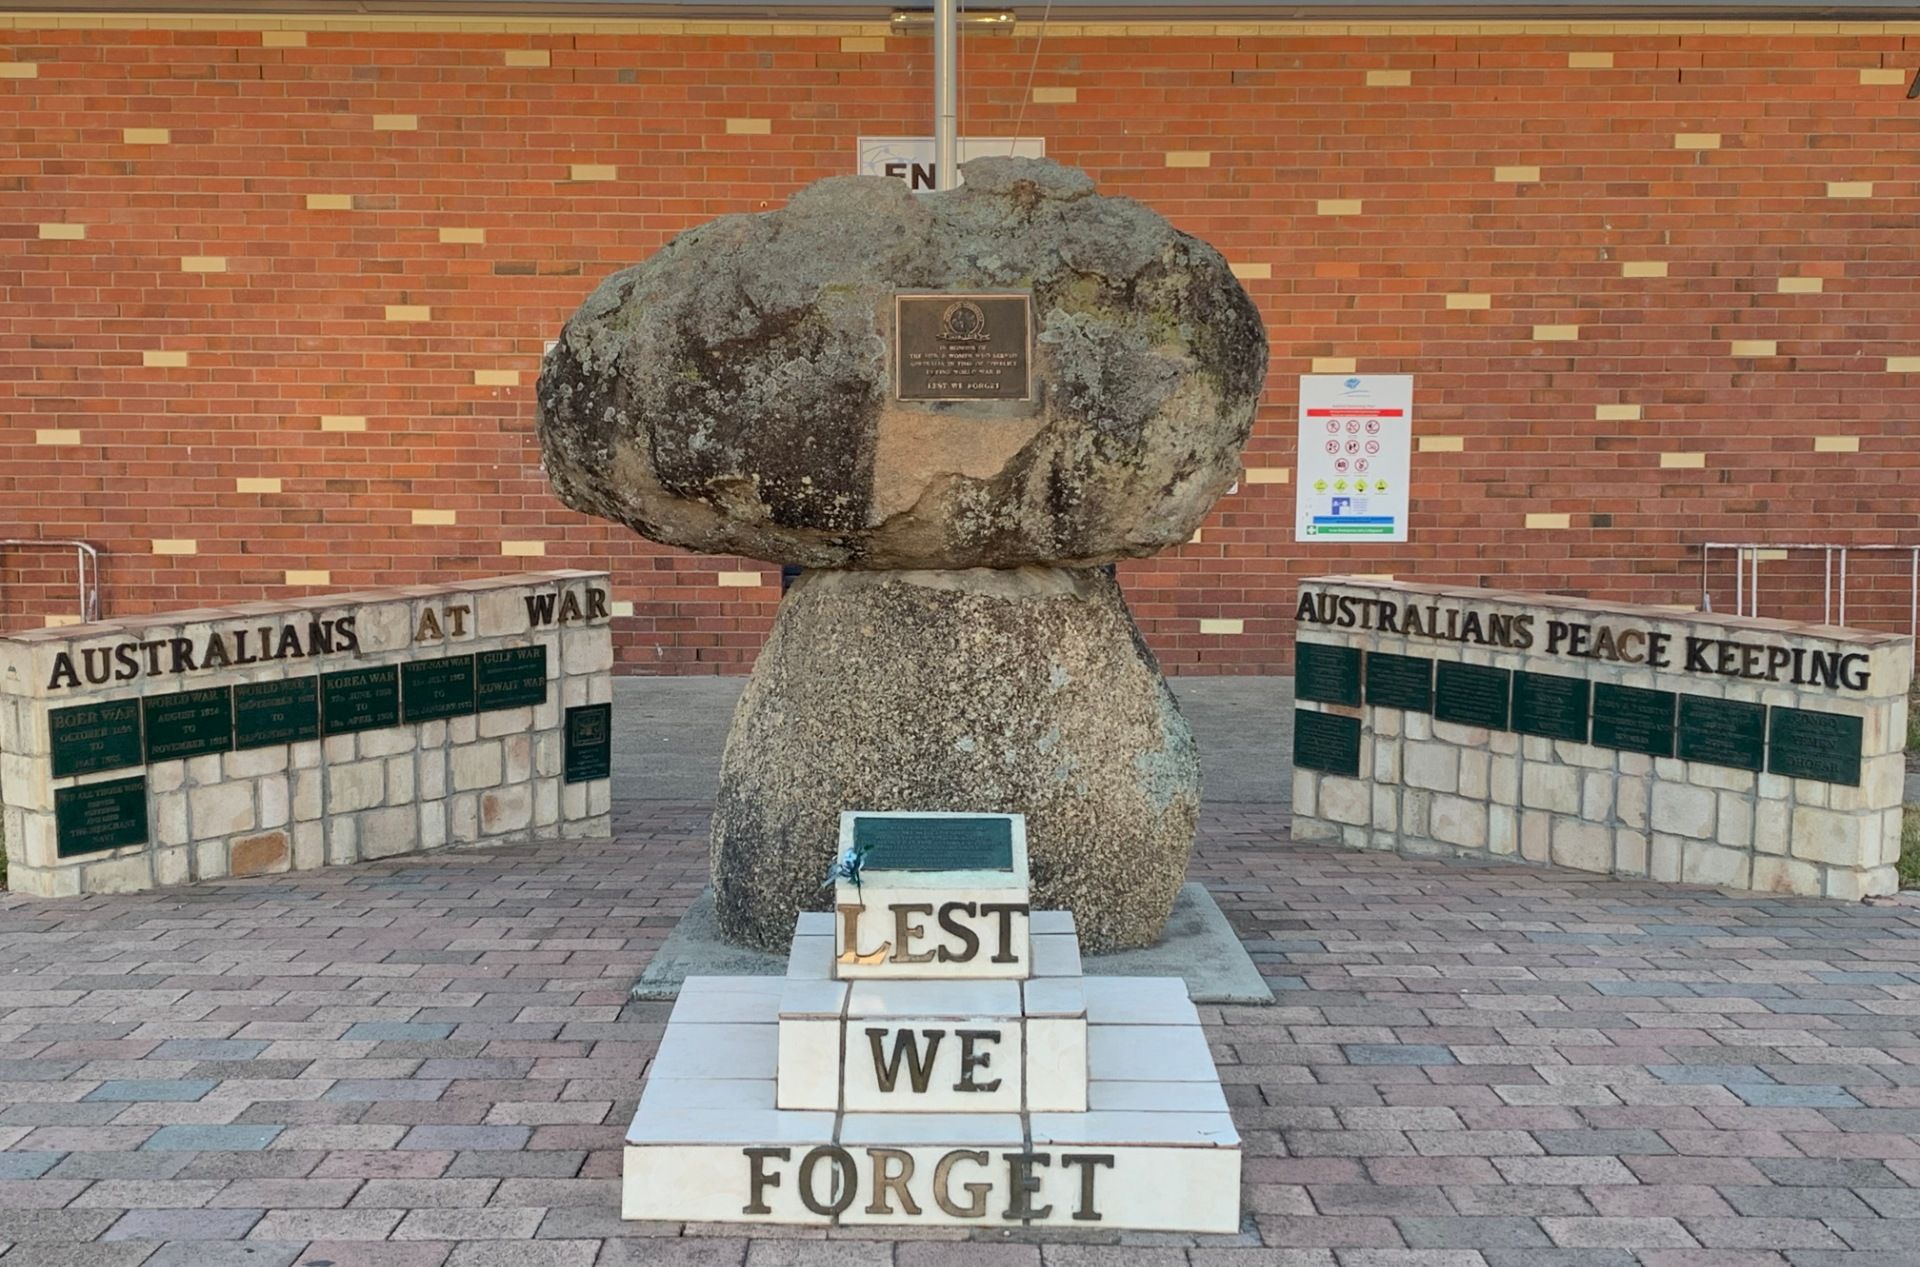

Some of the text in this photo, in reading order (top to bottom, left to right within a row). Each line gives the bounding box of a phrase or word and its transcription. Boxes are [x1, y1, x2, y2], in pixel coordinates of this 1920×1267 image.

[47, 588, 609, 690] AUSTRALIANS AT WAR
[1295, 591, 1871, 691] AUSTRALIANS PEACE KEEPING
[449, 656, 471, 668] WAR
[483, 647, 541, 665] GULF WAR
[236, 682, 279, 697] WORLD
[325, 671, 396, 690] KOREA WAR
[522, 675, 546, 688] WAR
[145, 694, 190, 710] WORLD
[190, 690, 219, 703] WAR
[433, 689, 446, 699] TO
[355, 702, 369, 712] TO
[54, 705, 137, 729] BOER WAR
[158, 710, 196, 723] AUGUST
[271, 712, 285, 722] TO
[182, 723, 197, 734] TO
[837, 902, 1029, 964] LEST
[865, 1028, 1002, 1093] WE
[742, 1145, 1114, 1220] FORGET
